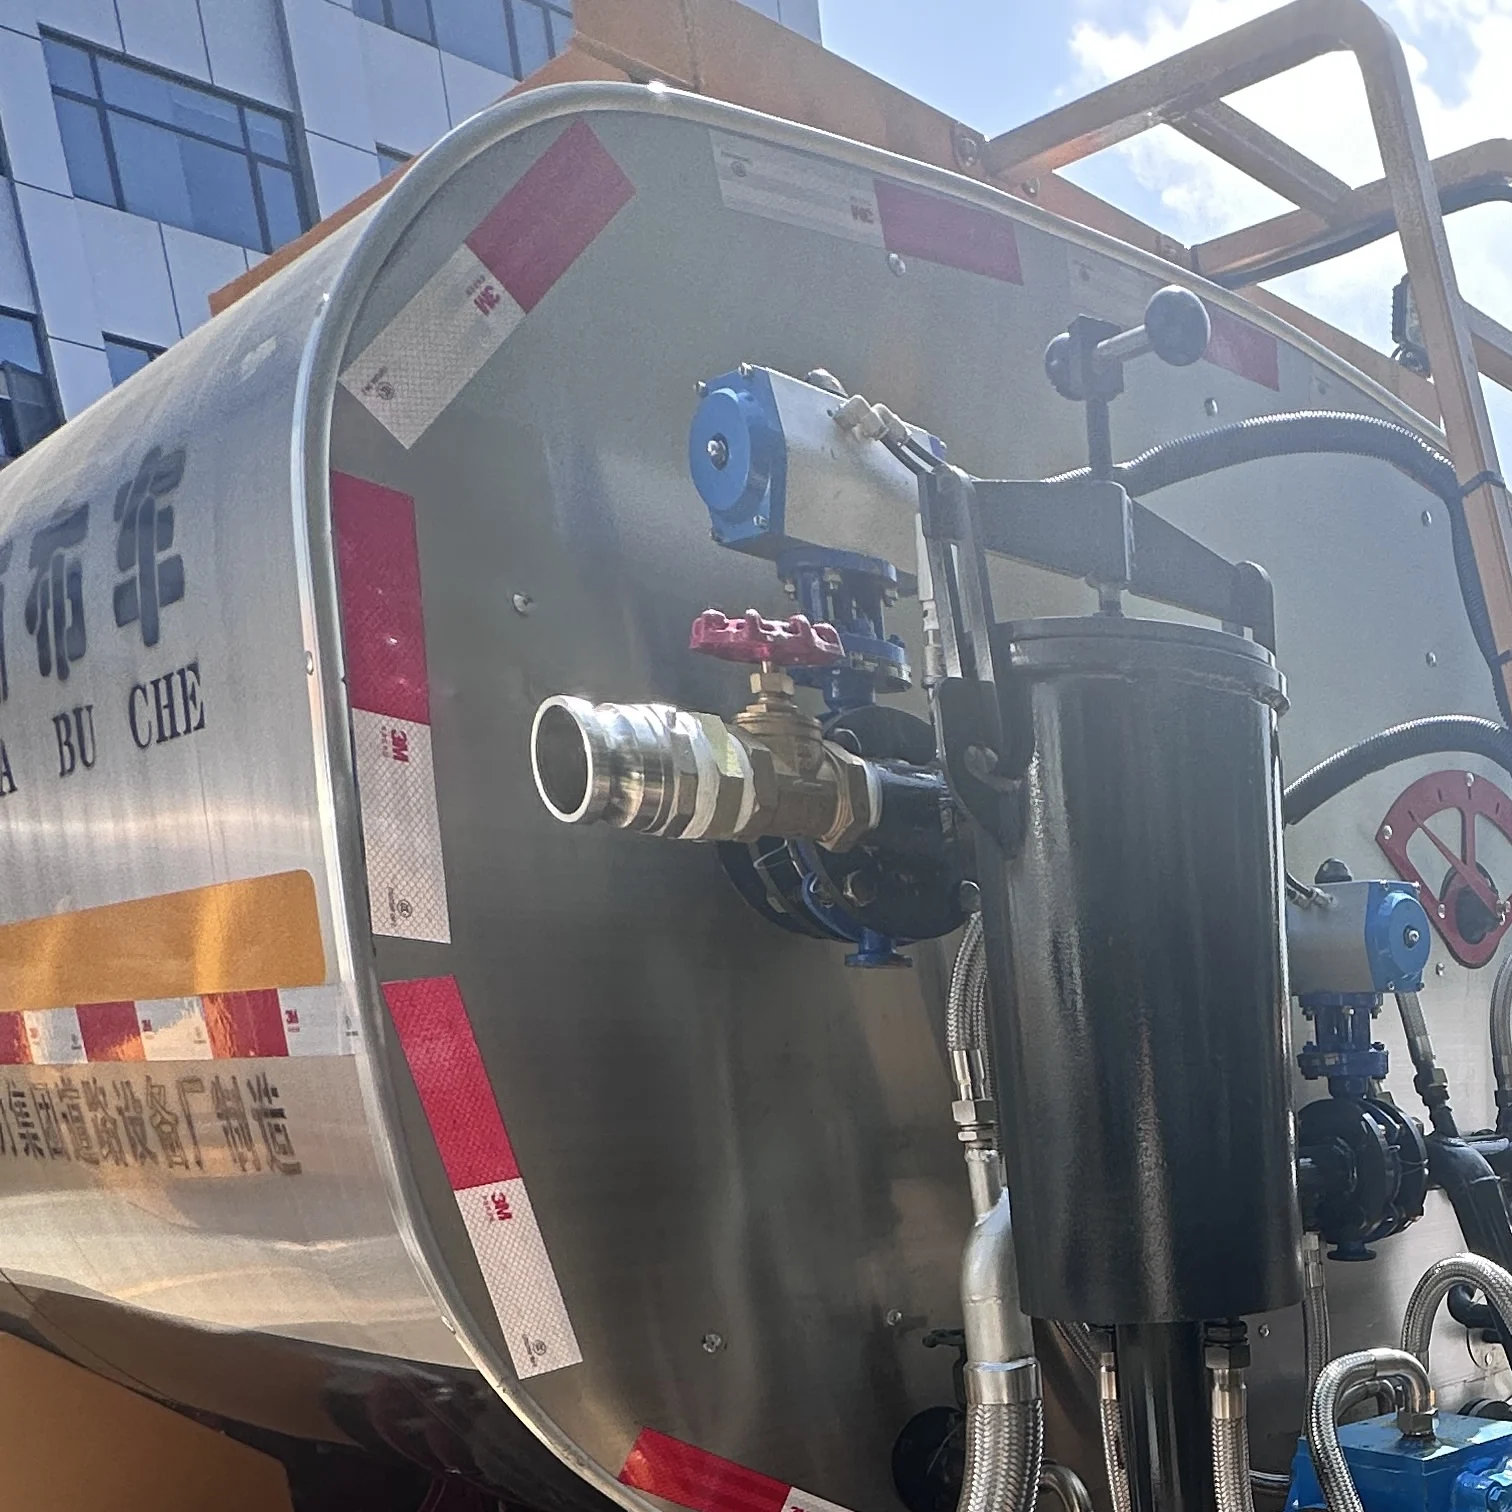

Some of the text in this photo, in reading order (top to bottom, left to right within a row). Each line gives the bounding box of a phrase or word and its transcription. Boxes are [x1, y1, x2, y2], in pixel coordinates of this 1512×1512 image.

[473, 285, 500, 317] 3M
[0, 444, 187, 702] 布车
[52, 704, 96, 778] BU
[128, 661, 206, 750] CHE
[391, 728, 409, 762] 3M
[490, 1190, 513, 1221] 3M
